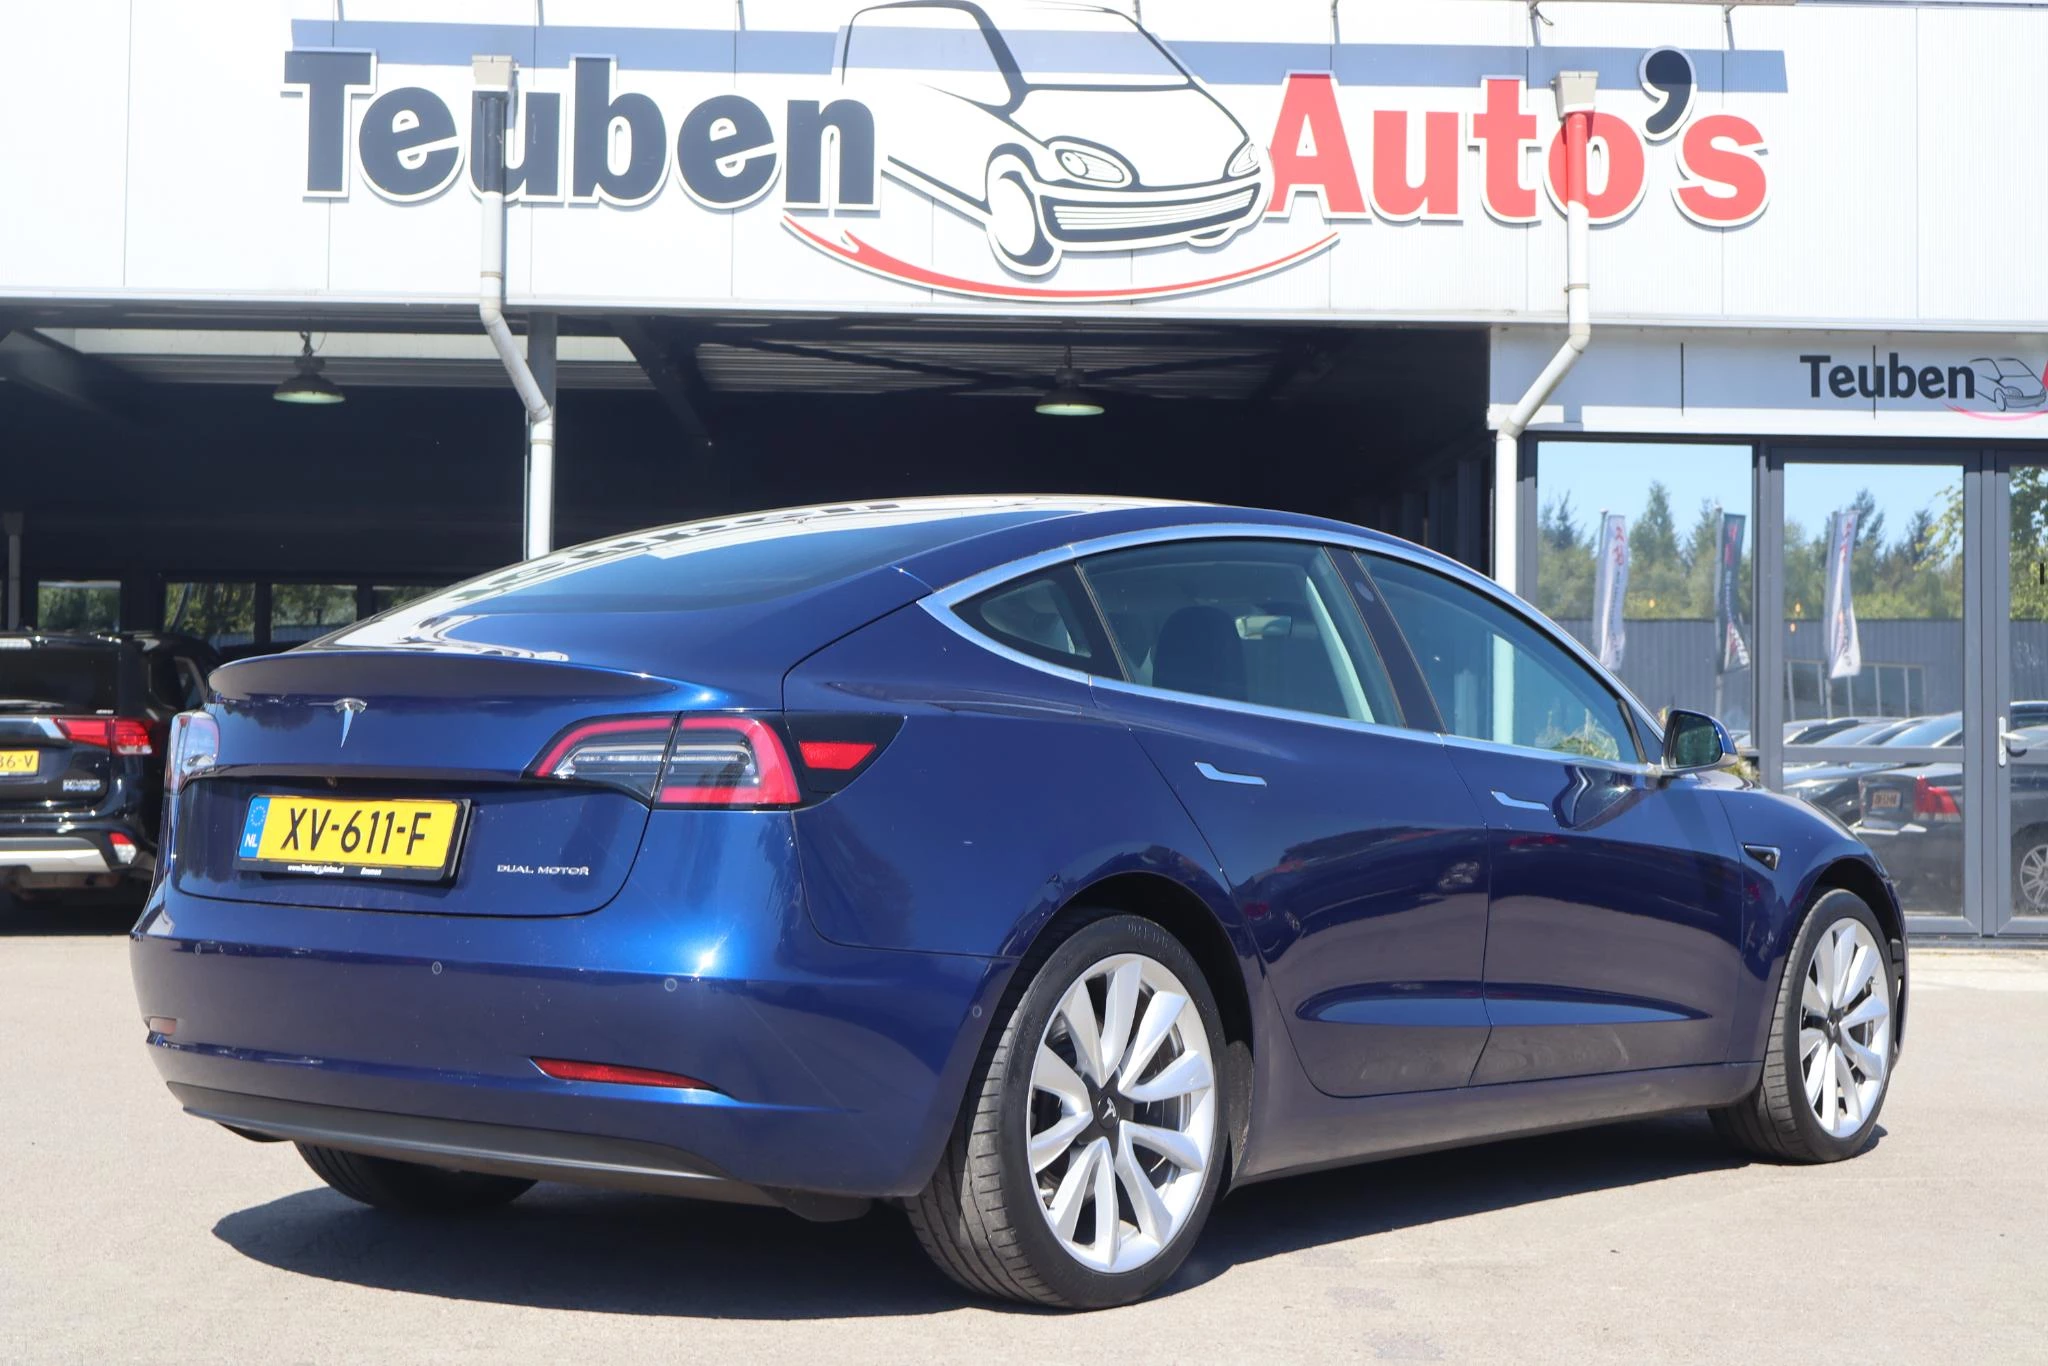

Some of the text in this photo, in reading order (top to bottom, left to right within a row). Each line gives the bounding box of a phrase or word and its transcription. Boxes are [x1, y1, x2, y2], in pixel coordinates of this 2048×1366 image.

[284, 48, 1768, 221] Teuben Auto's
[1799, 352, 1976, 399] Teuben
[244, 833, 258, 848] NL
[280, 807, 432, 856] XV-611-F
[496, 864, 589, 876] DUAL MOTOR
